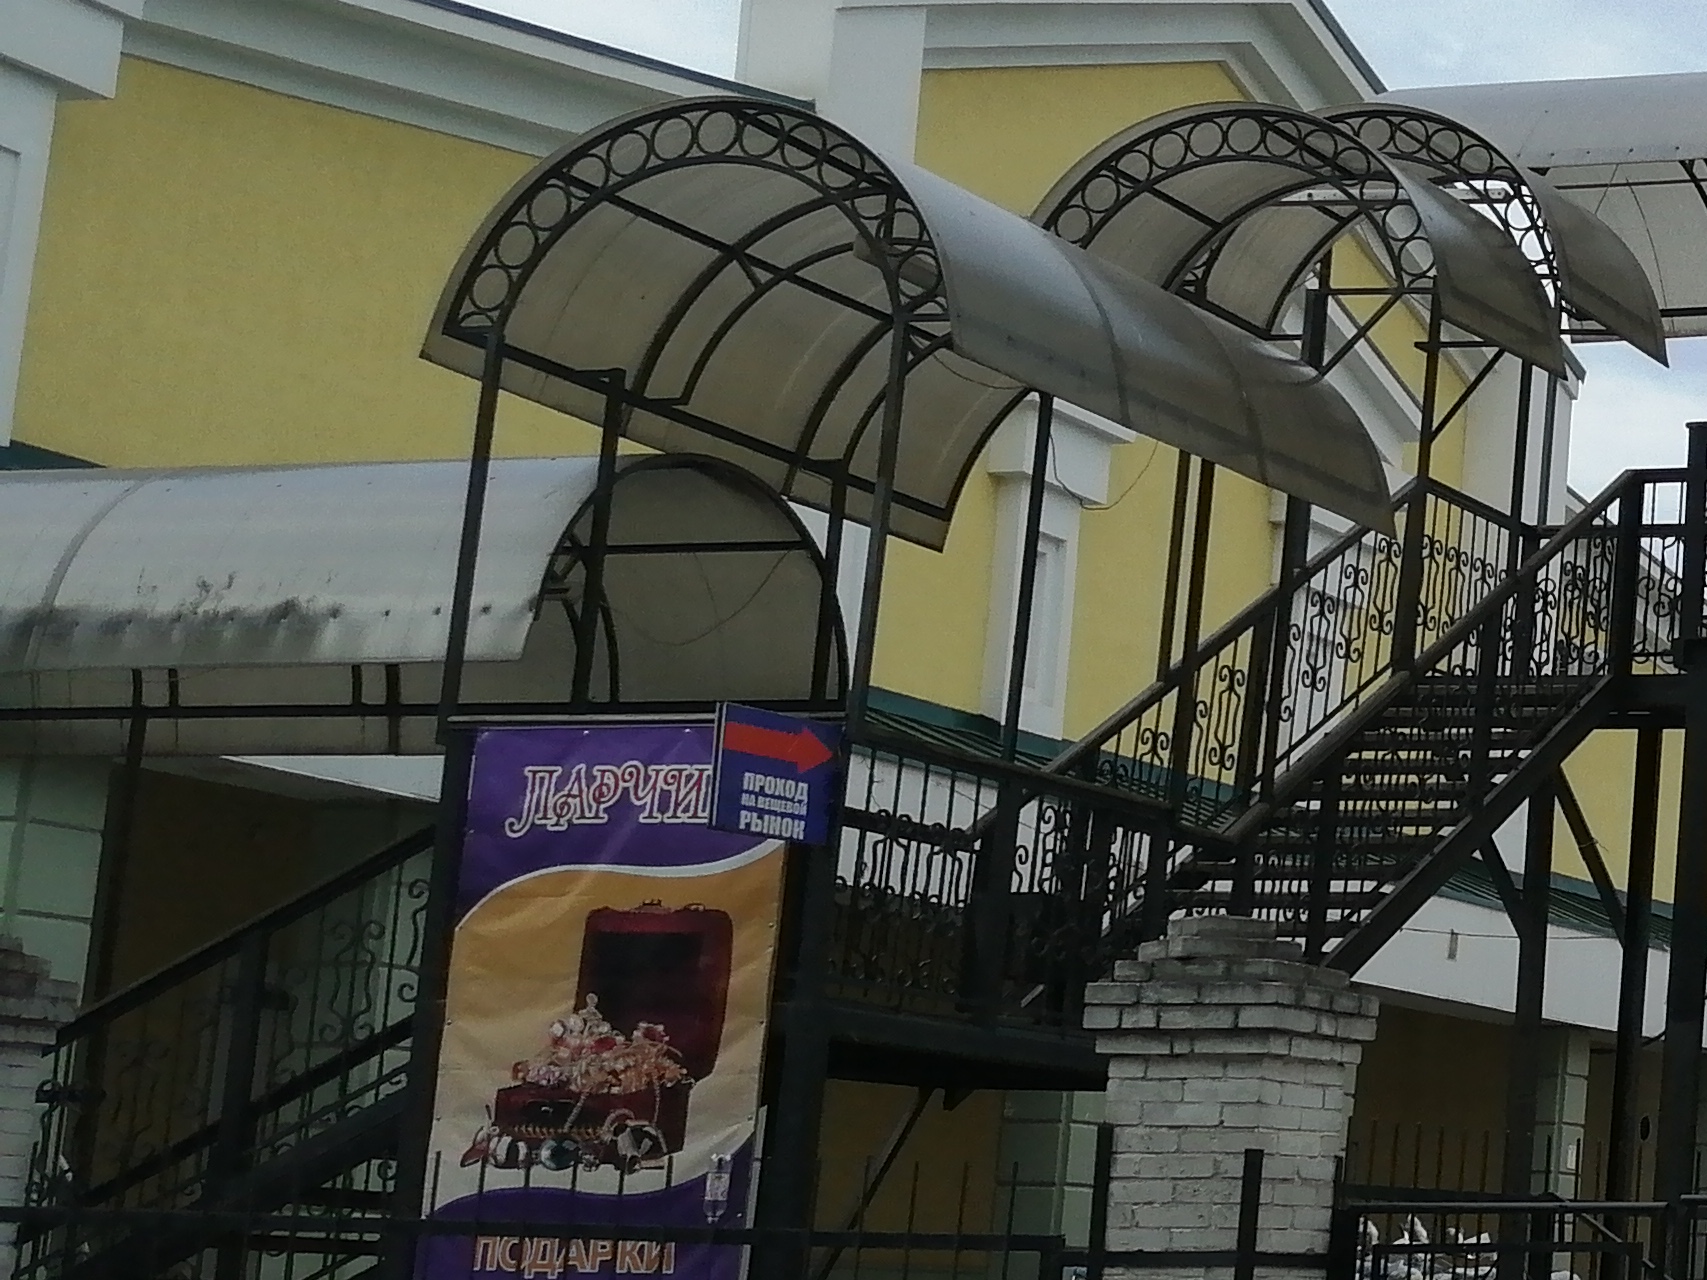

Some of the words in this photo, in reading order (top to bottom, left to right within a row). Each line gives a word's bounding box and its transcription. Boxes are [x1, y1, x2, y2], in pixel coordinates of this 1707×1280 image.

[504, 760, 712, 838] ЛАРЧИ
[742, 772, 808, 802] ПРОХОД
[741, 793, 756, 807] НА
[757, 795, 807, 816] ВЕЩЕВОЙ
[739, 810, 806, 840] РЫНОК
[473, 1235, 675, 1280] ПОДАРКИ
